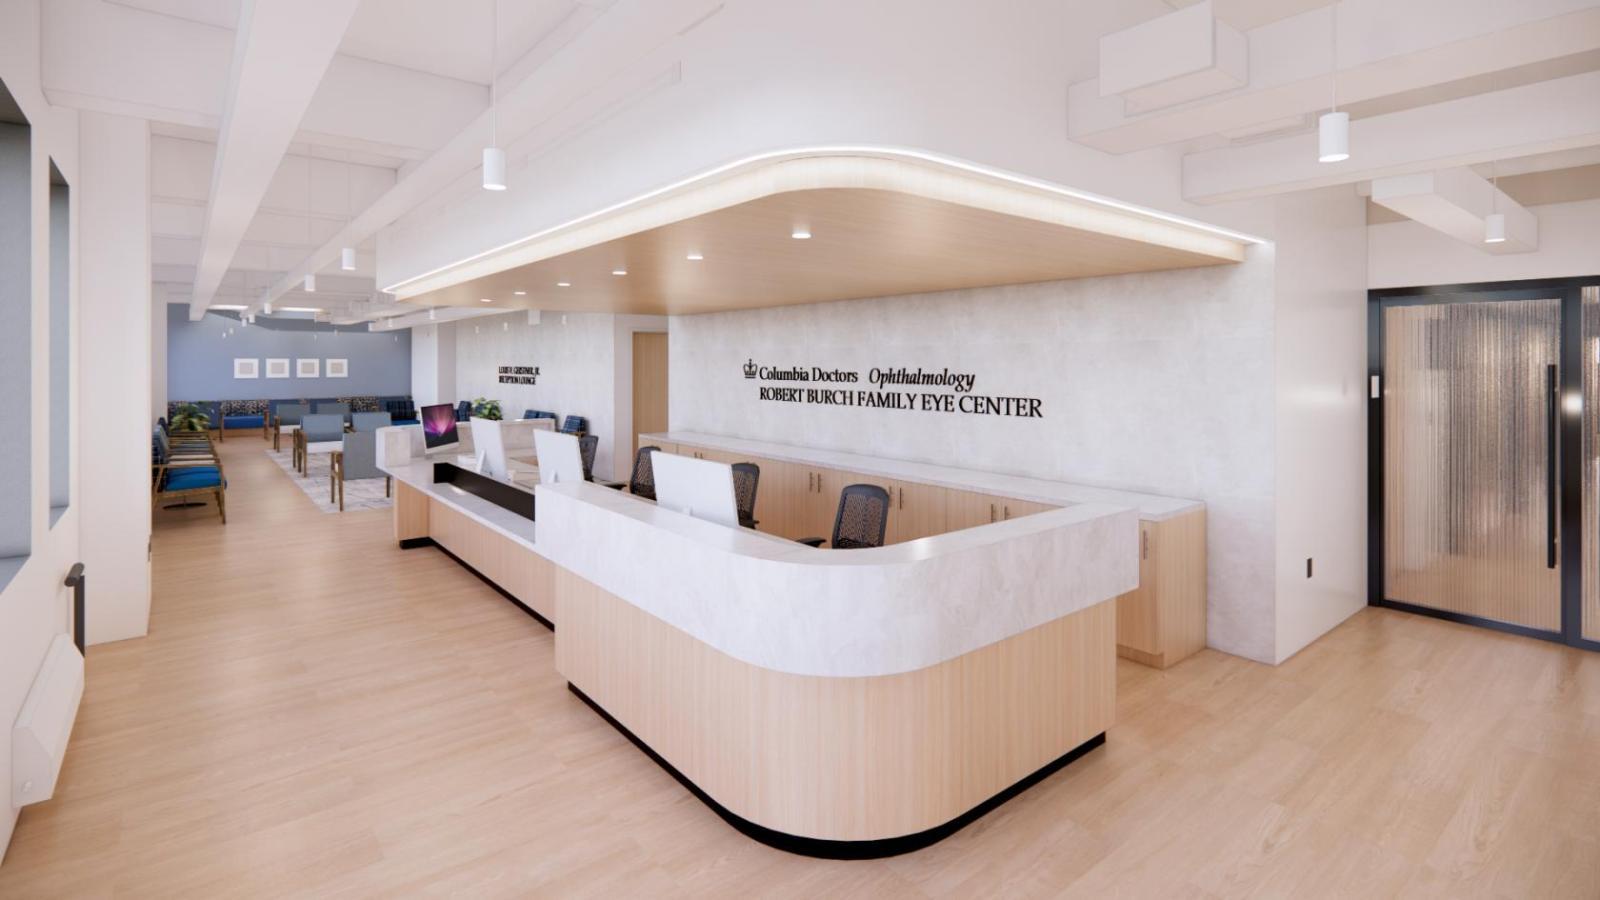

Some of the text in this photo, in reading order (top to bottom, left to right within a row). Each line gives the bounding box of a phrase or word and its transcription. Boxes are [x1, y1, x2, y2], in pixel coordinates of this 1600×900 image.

[759, 366, 976, 392] Columbia Doctors Ophthalmology
[760, 387, 1044, 418] ROBERT BURCH FAMILY EYE CENTER
